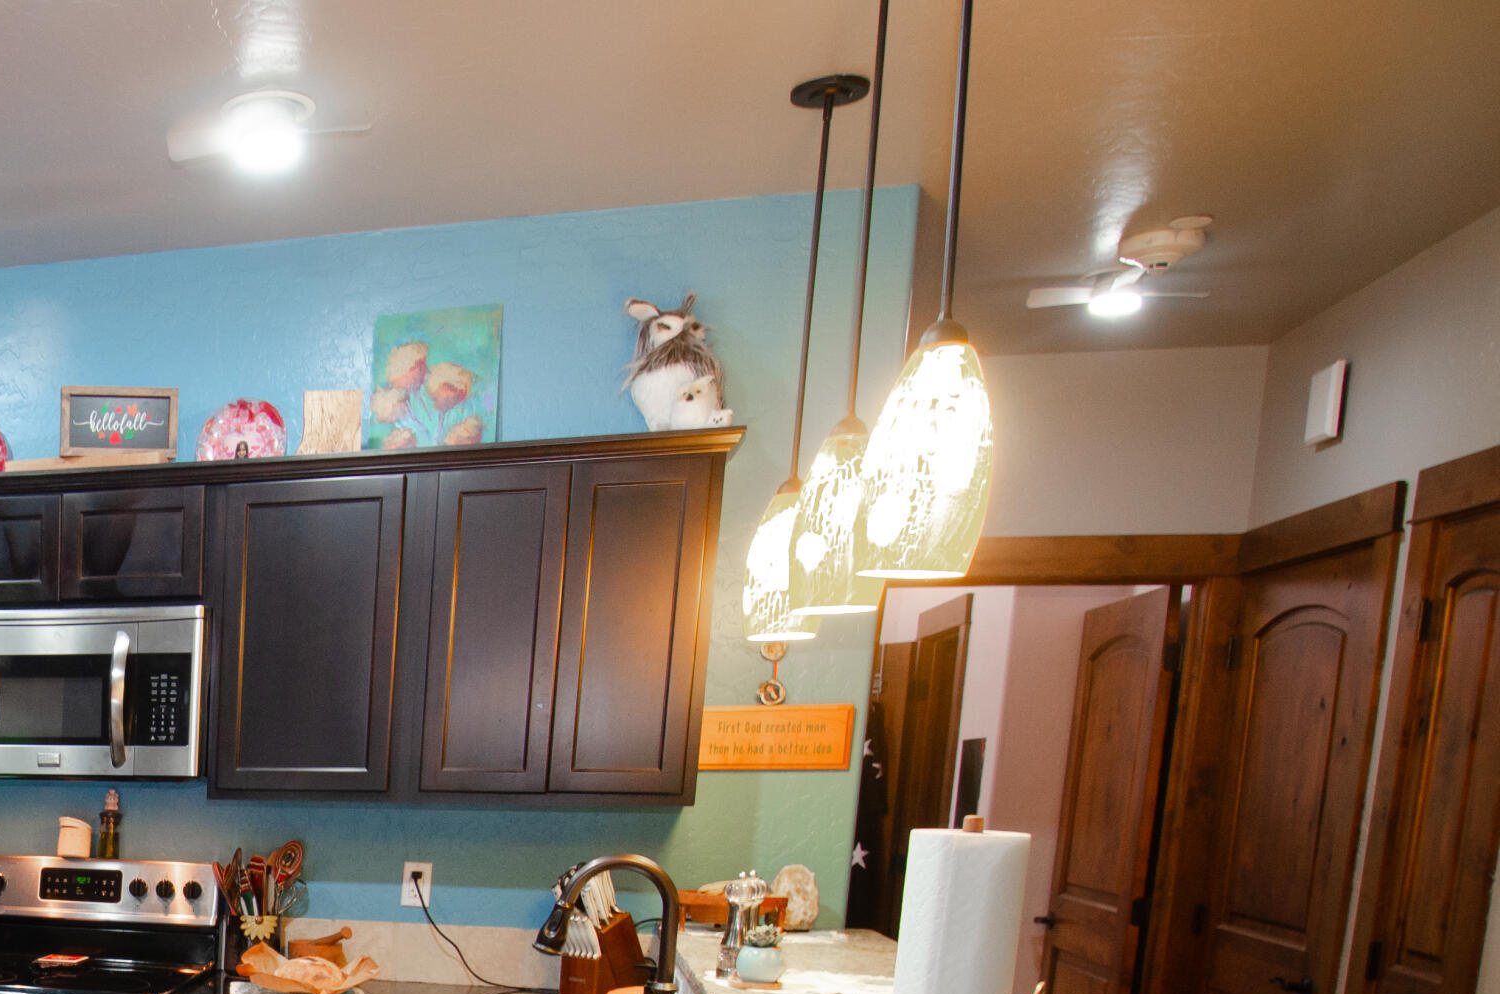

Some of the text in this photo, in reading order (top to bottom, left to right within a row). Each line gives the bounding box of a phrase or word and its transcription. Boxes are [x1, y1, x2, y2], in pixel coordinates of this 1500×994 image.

[718, 720, 827, 733] First God created man
[734, 743, 745, 754] he
[748, 743, 764, 754] had
[778, 743, 808, 754] better
[813, 743, 832, 754] idea
